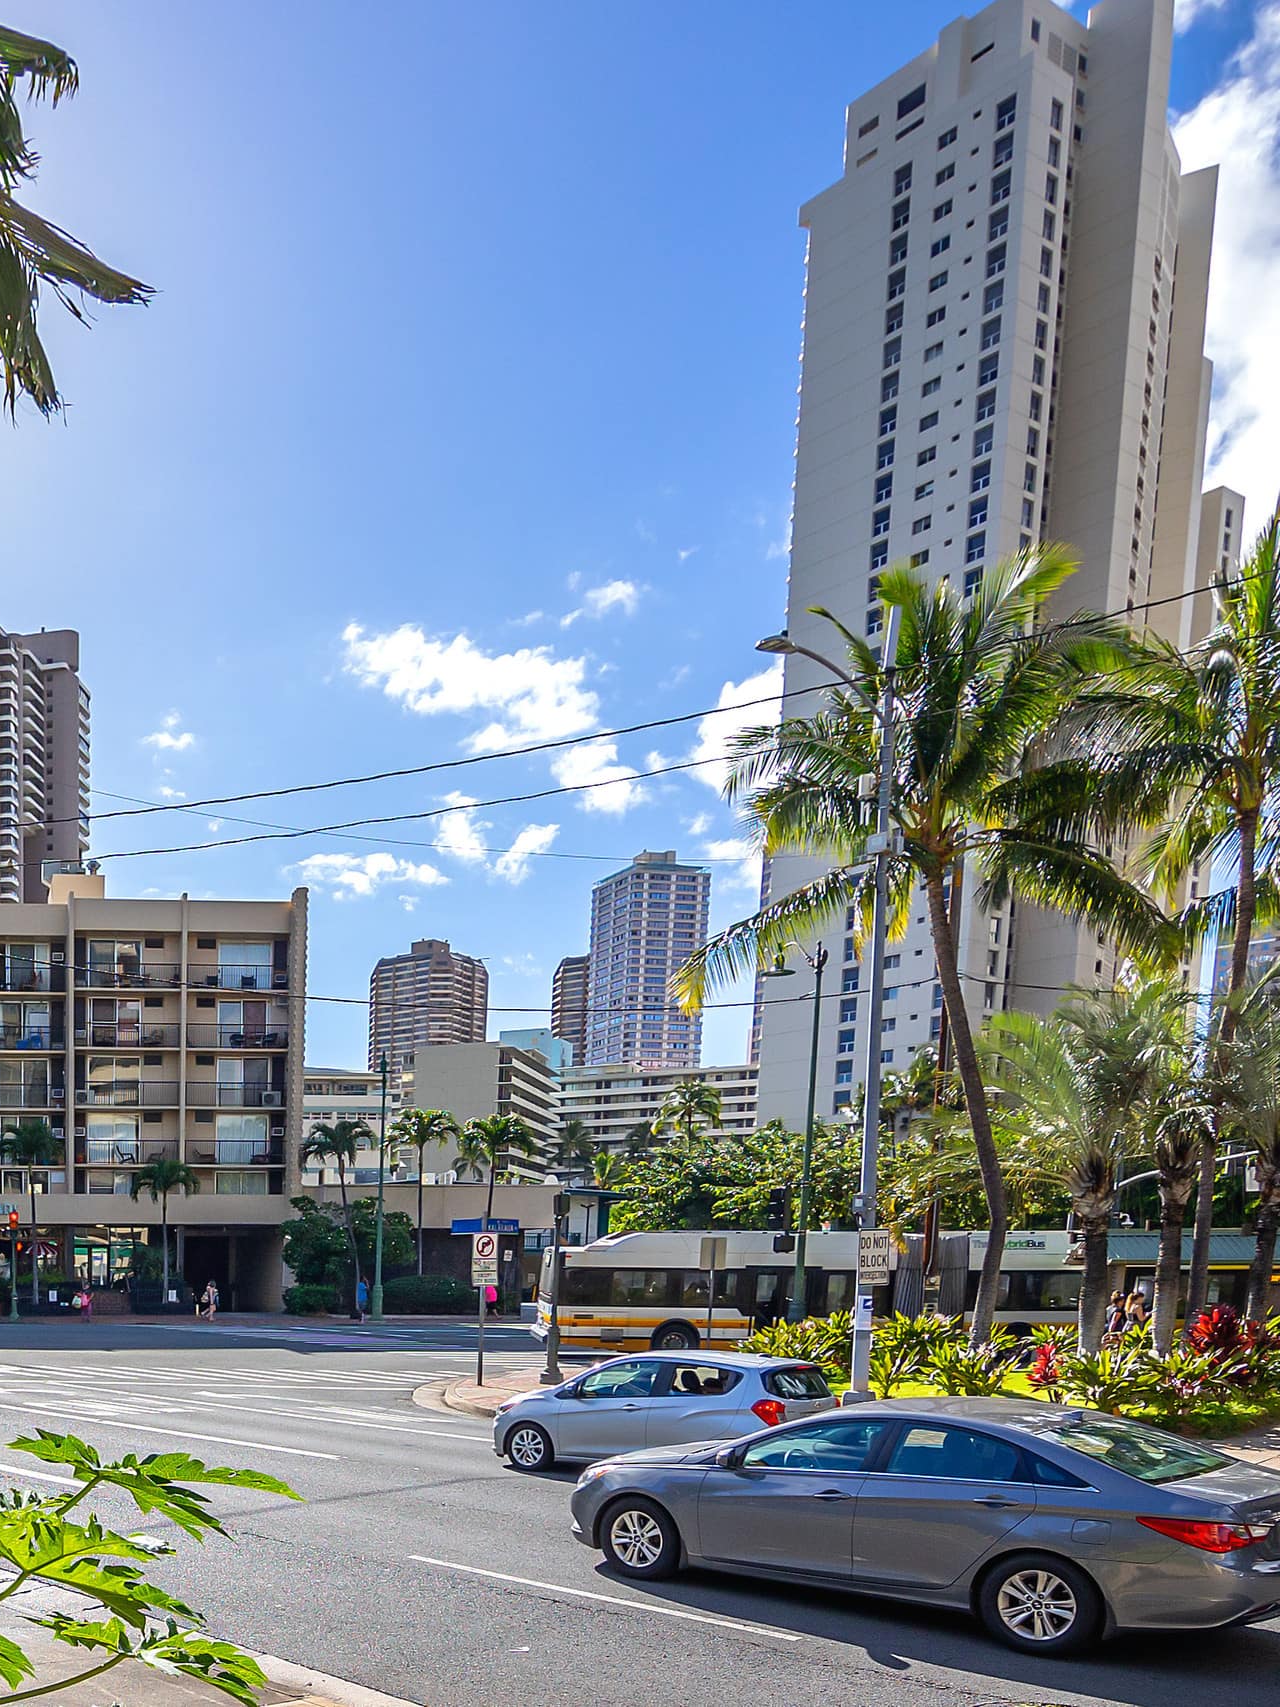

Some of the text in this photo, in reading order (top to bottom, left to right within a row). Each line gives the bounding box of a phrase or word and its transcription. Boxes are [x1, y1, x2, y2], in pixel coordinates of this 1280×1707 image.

[861, 1236, 888, 1249] DO NOT
[861, 1255, 888, 1267] BLOCK
